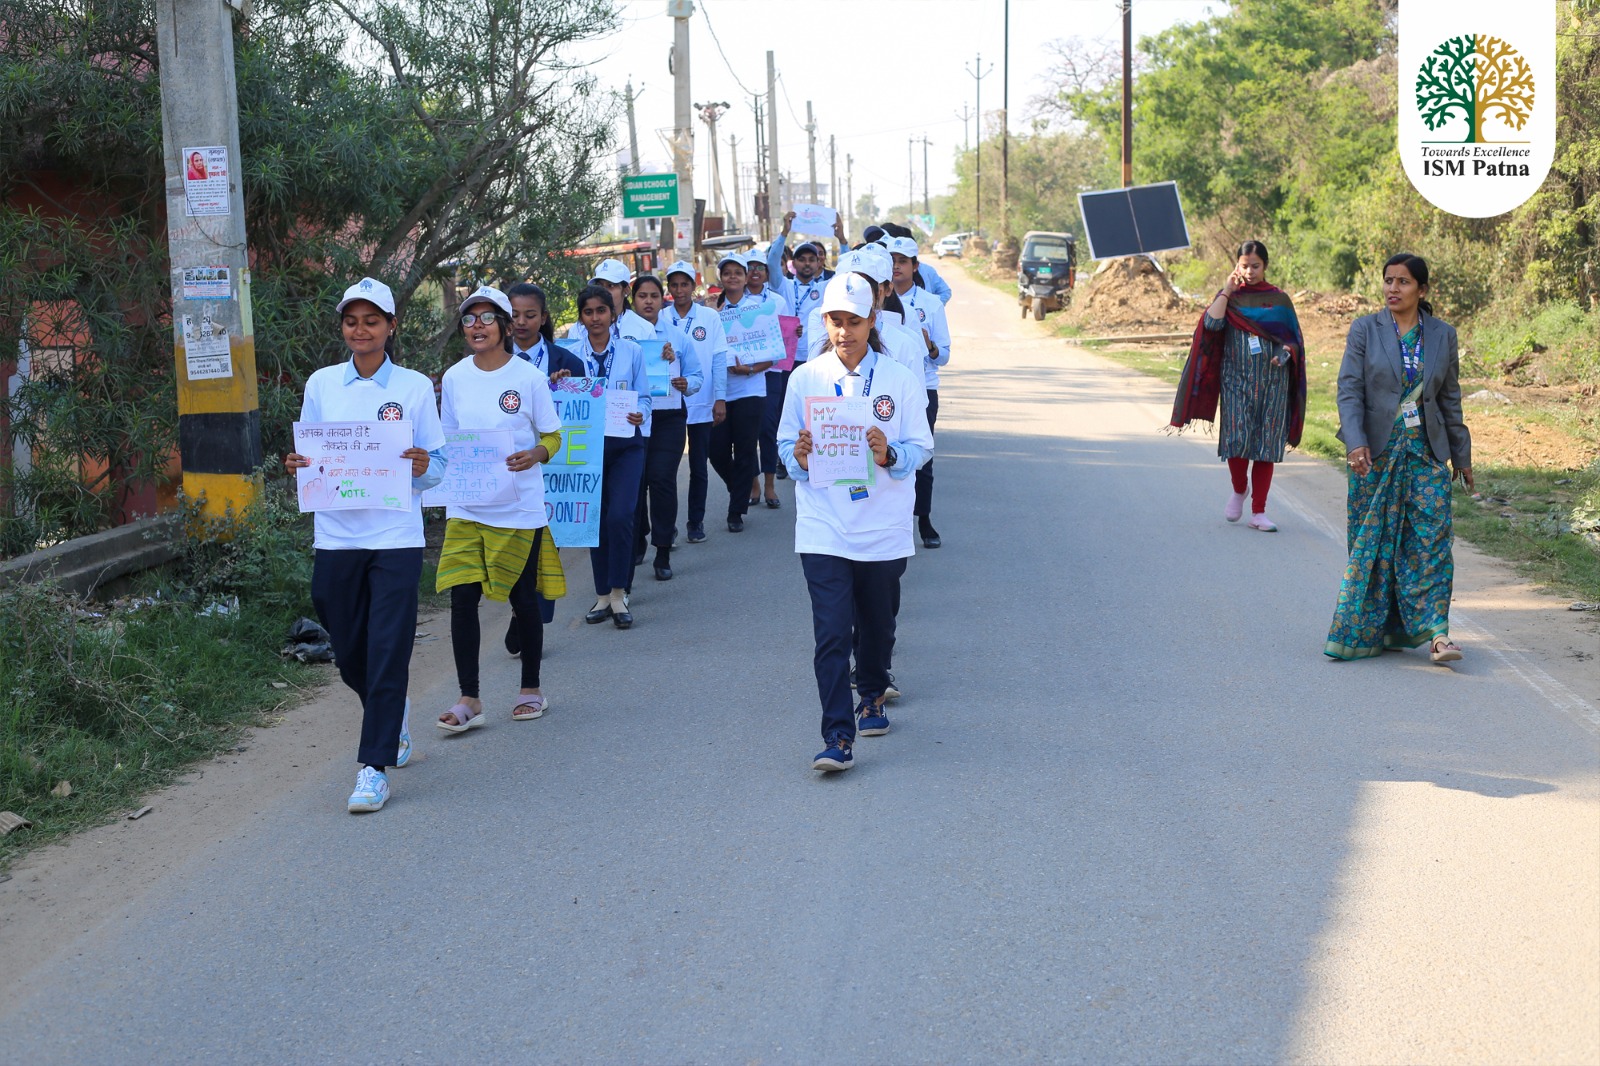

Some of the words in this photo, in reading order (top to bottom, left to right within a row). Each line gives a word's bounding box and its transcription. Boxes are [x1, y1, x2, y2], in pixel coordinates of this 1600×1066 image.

[625, 181, 643, 190] DIAN
[644, 180, 667, 188] SCHOOL
[668, 179, 676, 187] OF
[630, 192, 670, 202] MANAGEMENT
[563, 399, 590, 421] AND
[813, 407, 837, 421] MY
[821, 424, 865, 441] FIRST
[815, 443, 860, 457] VOTE
[341, 480, 355, 488] MY
[543, 473, 601, 494] COUNTRY
